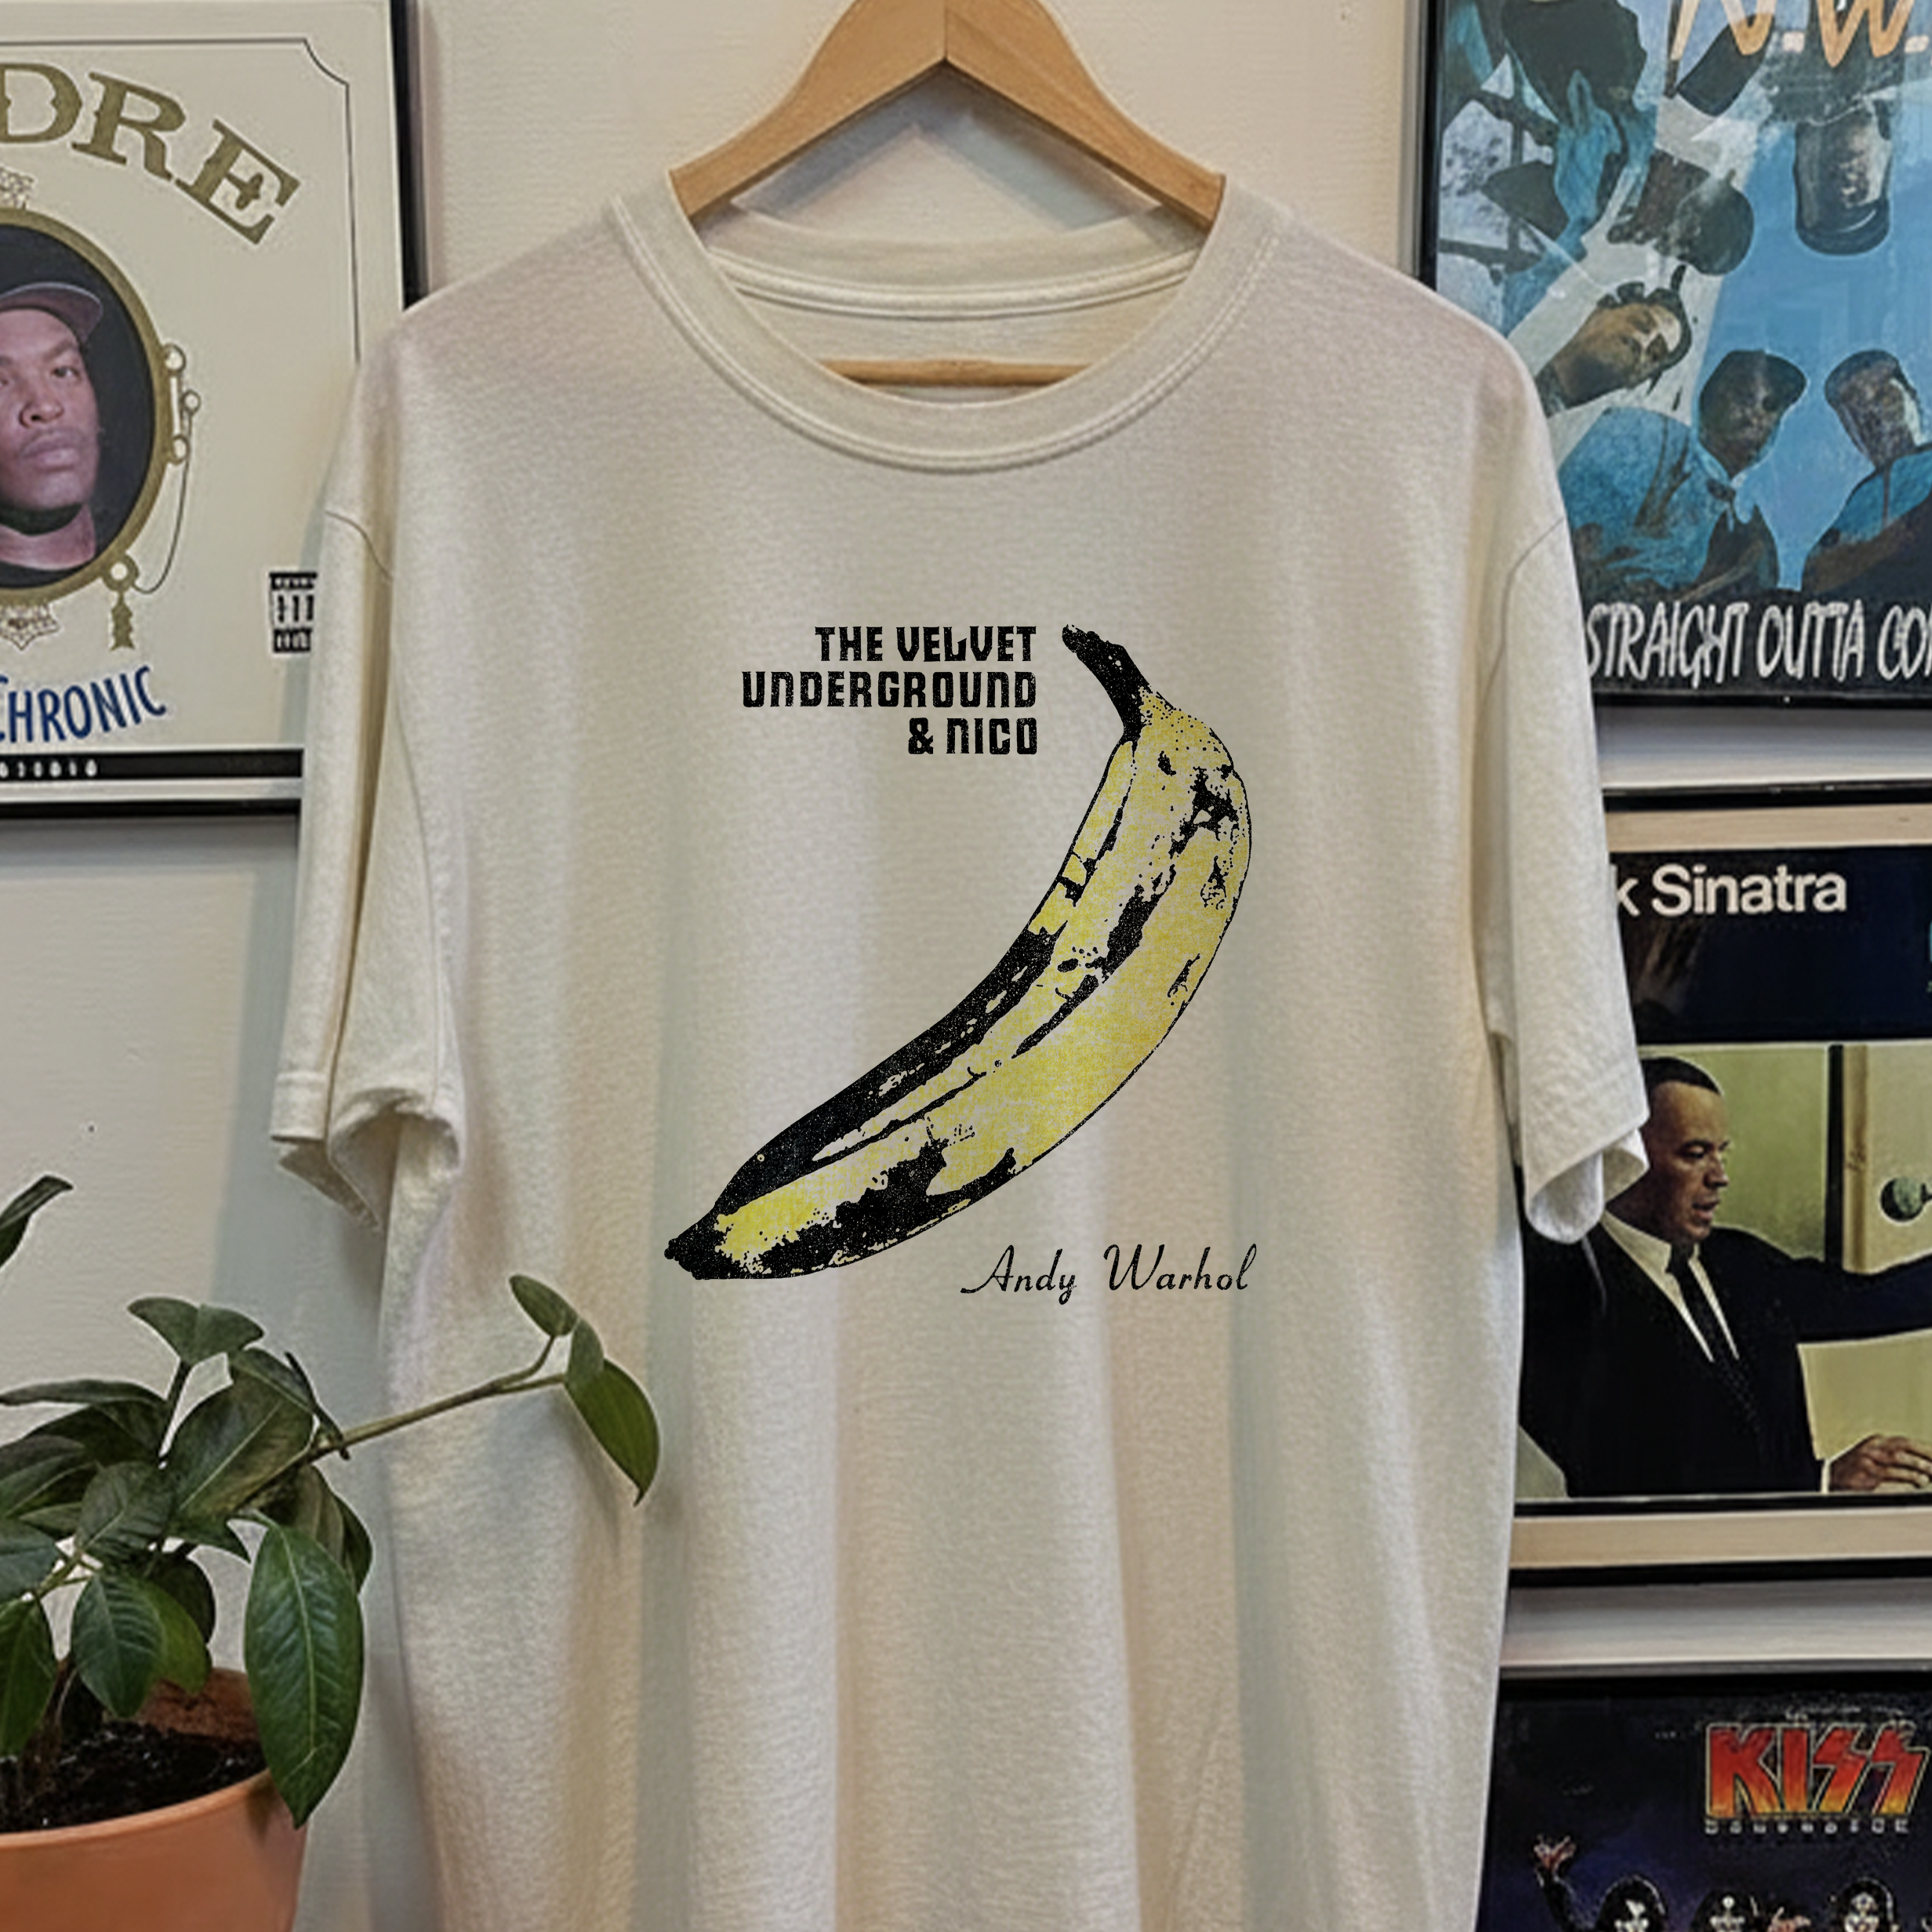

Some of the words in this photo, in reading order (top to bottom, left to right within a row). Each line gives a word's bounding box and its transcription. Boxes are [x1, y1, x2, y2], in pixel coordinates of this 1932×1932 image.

[0, 62, 300, 245] DRE
[815, 626, 883, 662] THE
[896, 626, 1037, 662] VELVET
[1586, 600, 1749, 689] STRAIGHT
[1756, 599, 1865, 682] OUTTA
[1878, 605, 1932, 681] CO
[0, 665, 167, 743] HRONIC
[742, 670, 1037, 707] UNDERGROUND
[908, 717, 934, 754] &
[946, 717, 1037, 754] NICO
[1651, 863, 1847, 917] Sinatra
[961, 1244, 1077, 1305] Andy
[1103, 1244, 1257, 1291] Warhol
[1705, 1722, 1931, 1817] KISS
